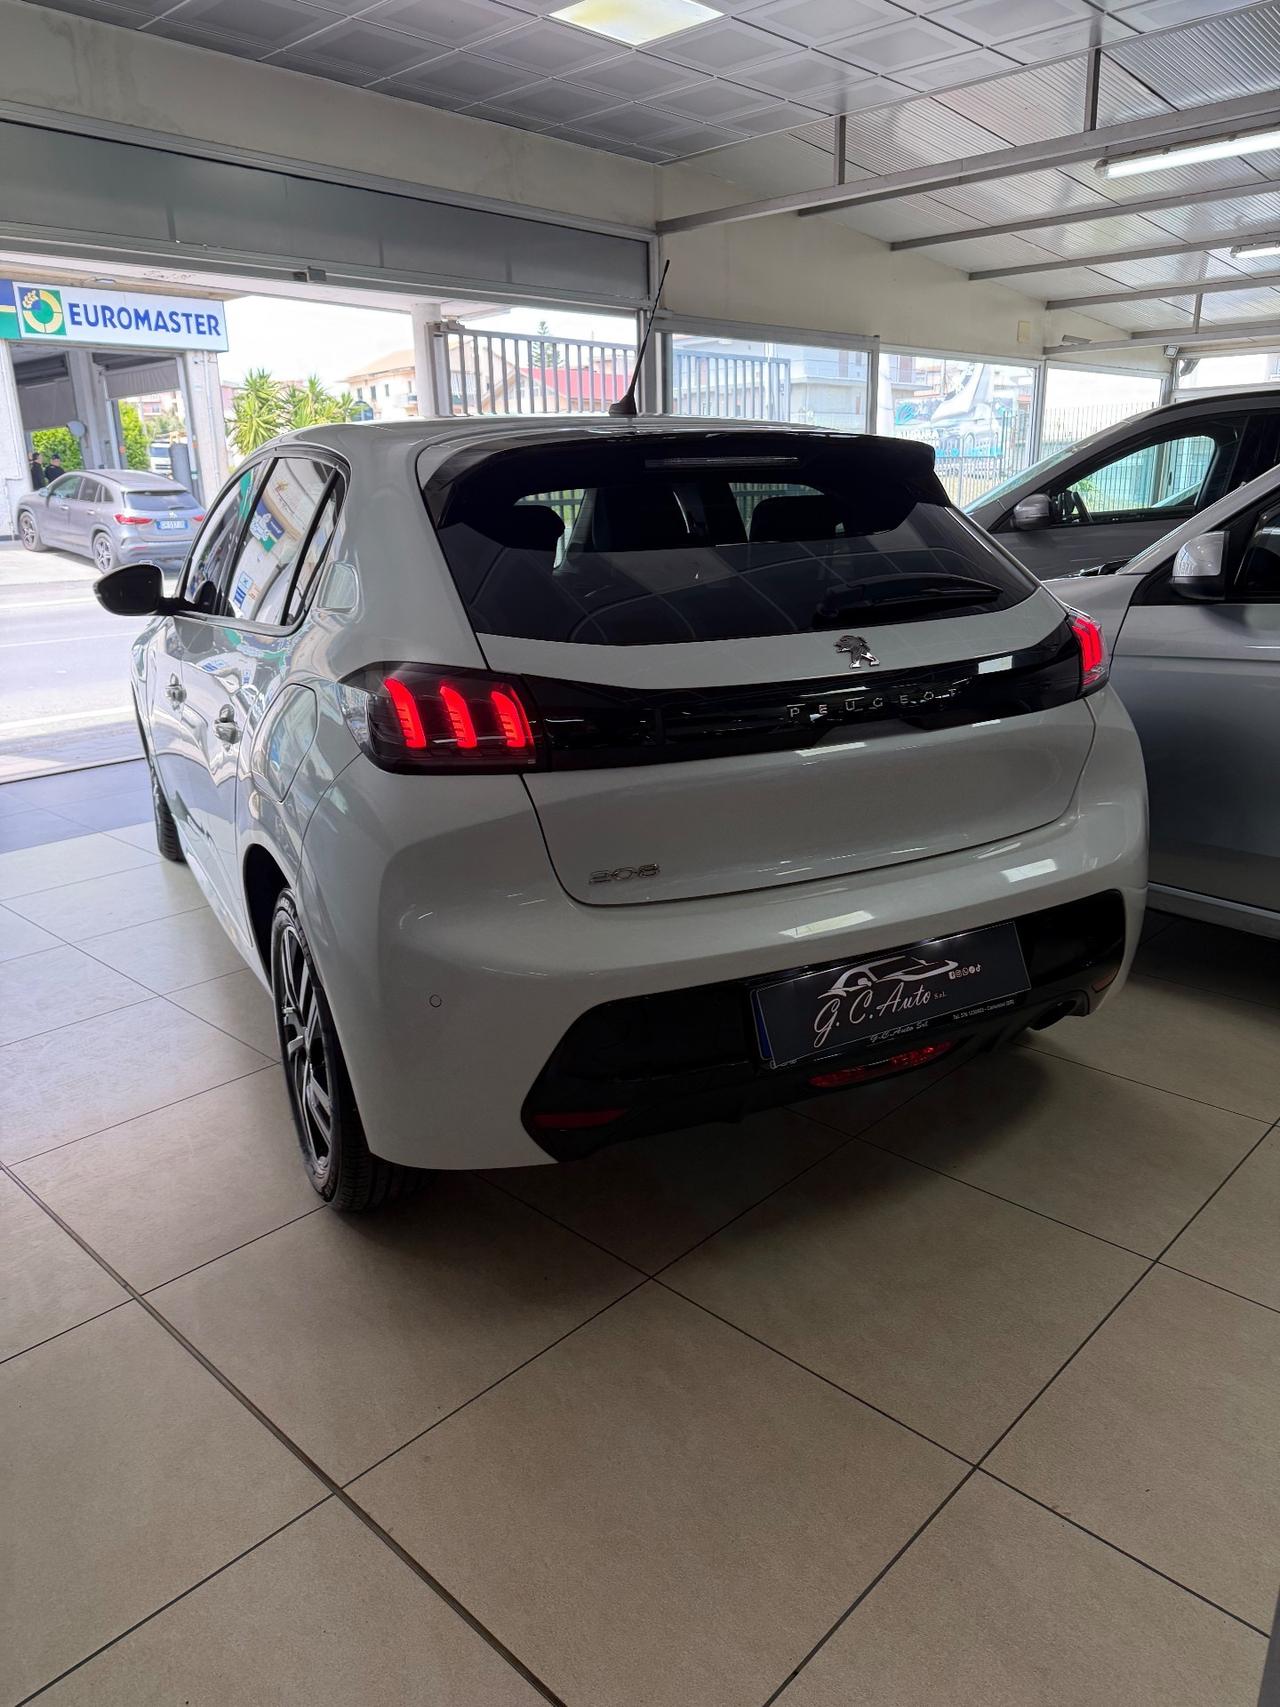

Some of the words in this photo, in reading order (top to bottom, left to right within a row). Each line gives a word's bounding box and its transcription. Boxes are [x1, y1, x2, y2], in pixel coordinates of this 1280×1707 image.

[68, 302, 221, 336] EUROMASTER
[789, 687, 958, 719] PEUGEOT
[876, 981, 931, 1016] Auto
